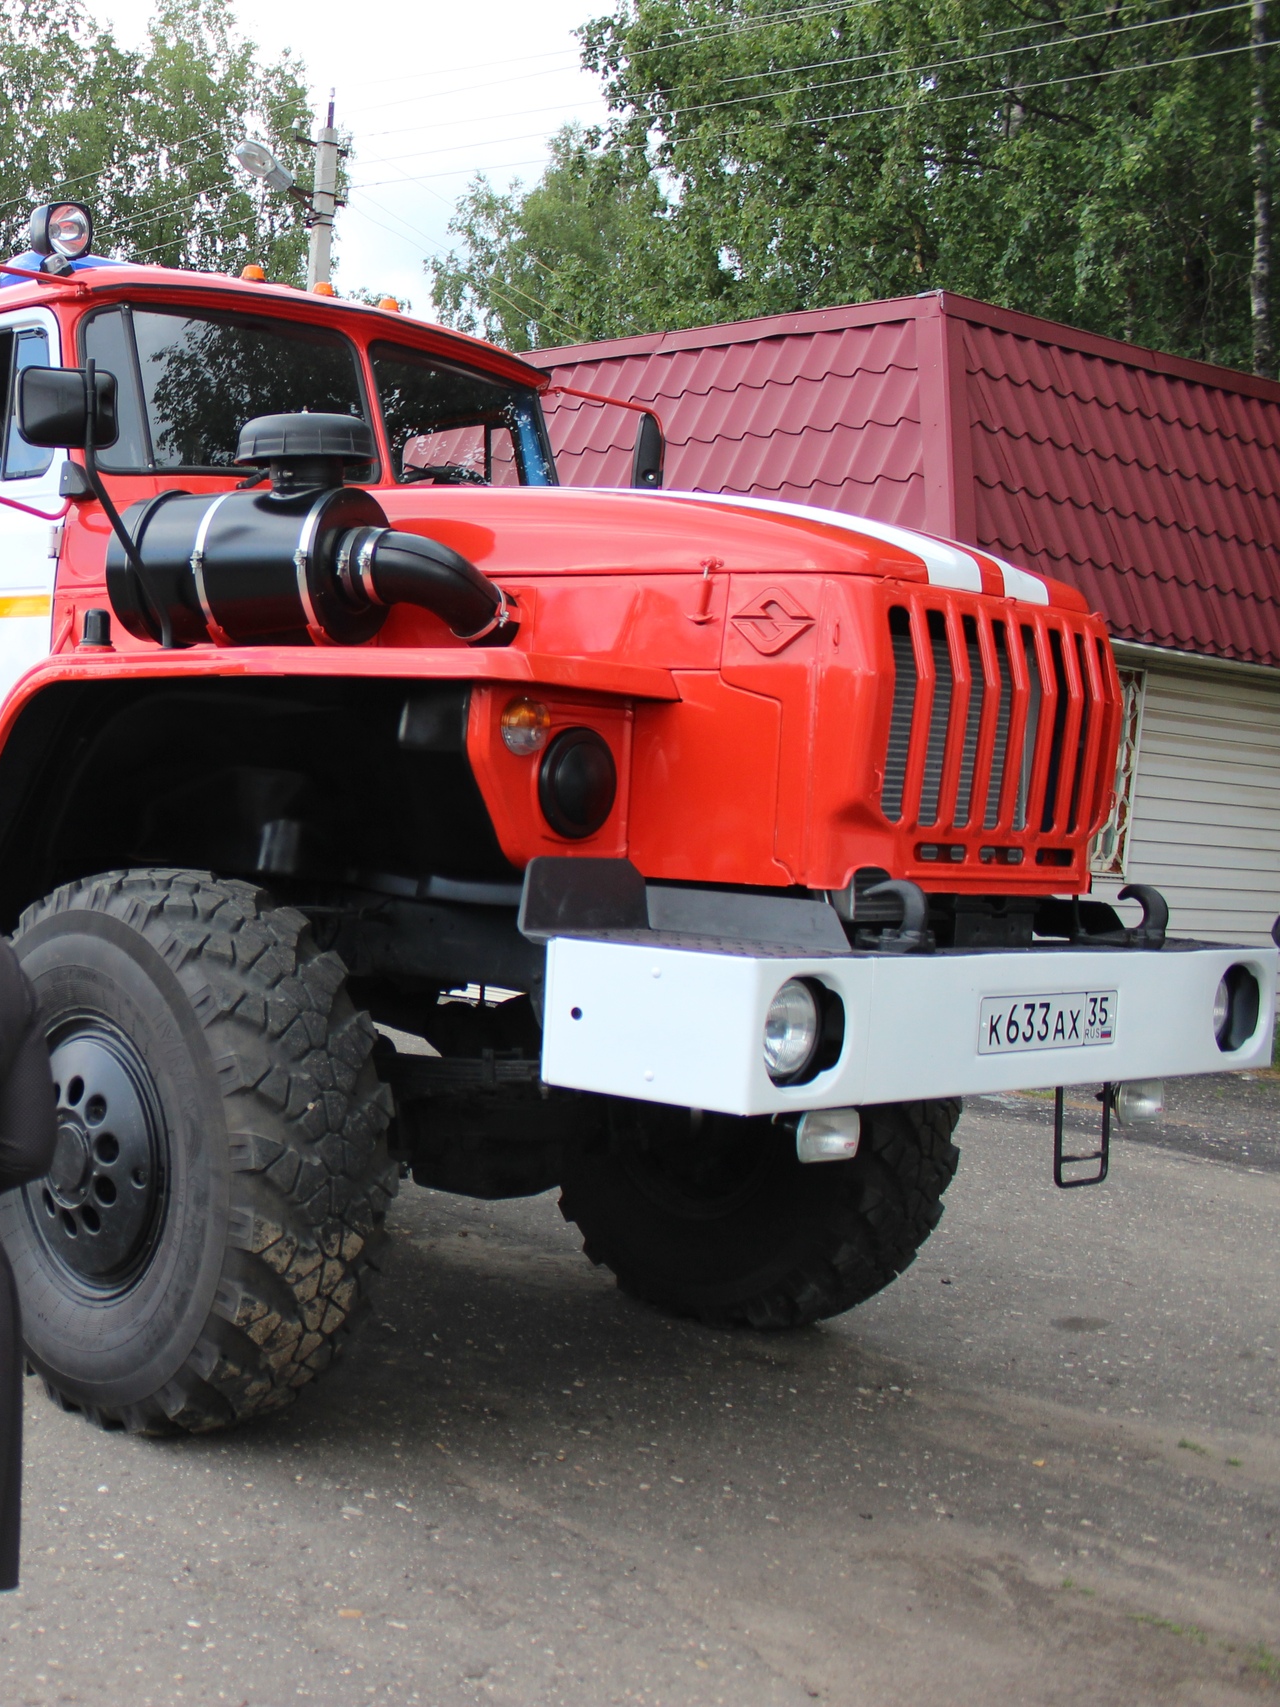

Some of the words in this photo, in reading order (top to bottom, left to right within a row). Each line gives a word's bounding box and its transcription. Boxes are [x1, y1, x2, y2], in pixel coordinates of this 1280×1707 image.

[988, 1002, 1081, 1046] К633АХ
[1088, 997, 1109, 1026] 35
[1085, 1028, 1100, 1039] RUS
